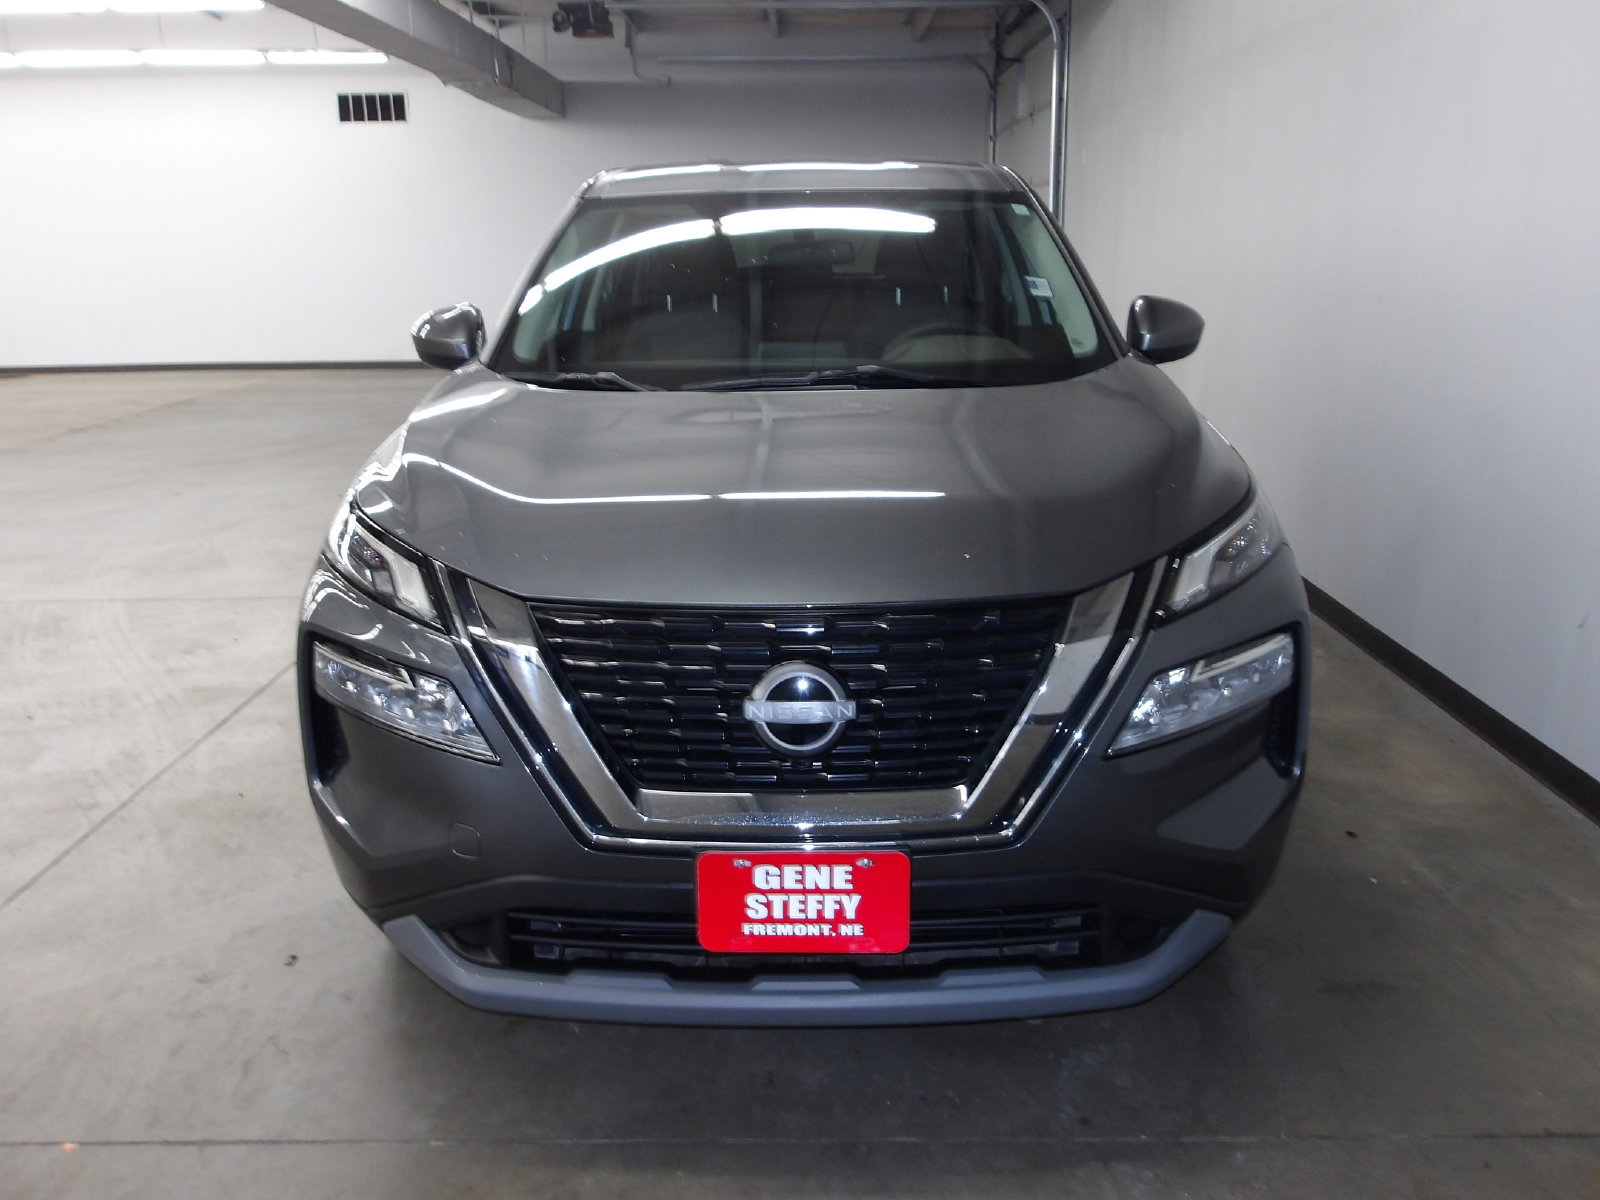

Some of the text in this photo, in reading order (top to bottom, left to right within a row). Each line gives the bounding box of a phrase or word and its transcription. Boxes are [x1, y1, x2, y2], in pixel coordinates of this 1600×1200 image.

[748, 704, 853, 719] NISSAN
[752, 865, 853, 889] GENE
[745, 894, 861, 919] STEFFY
[839, 924, 864, 936] NE
